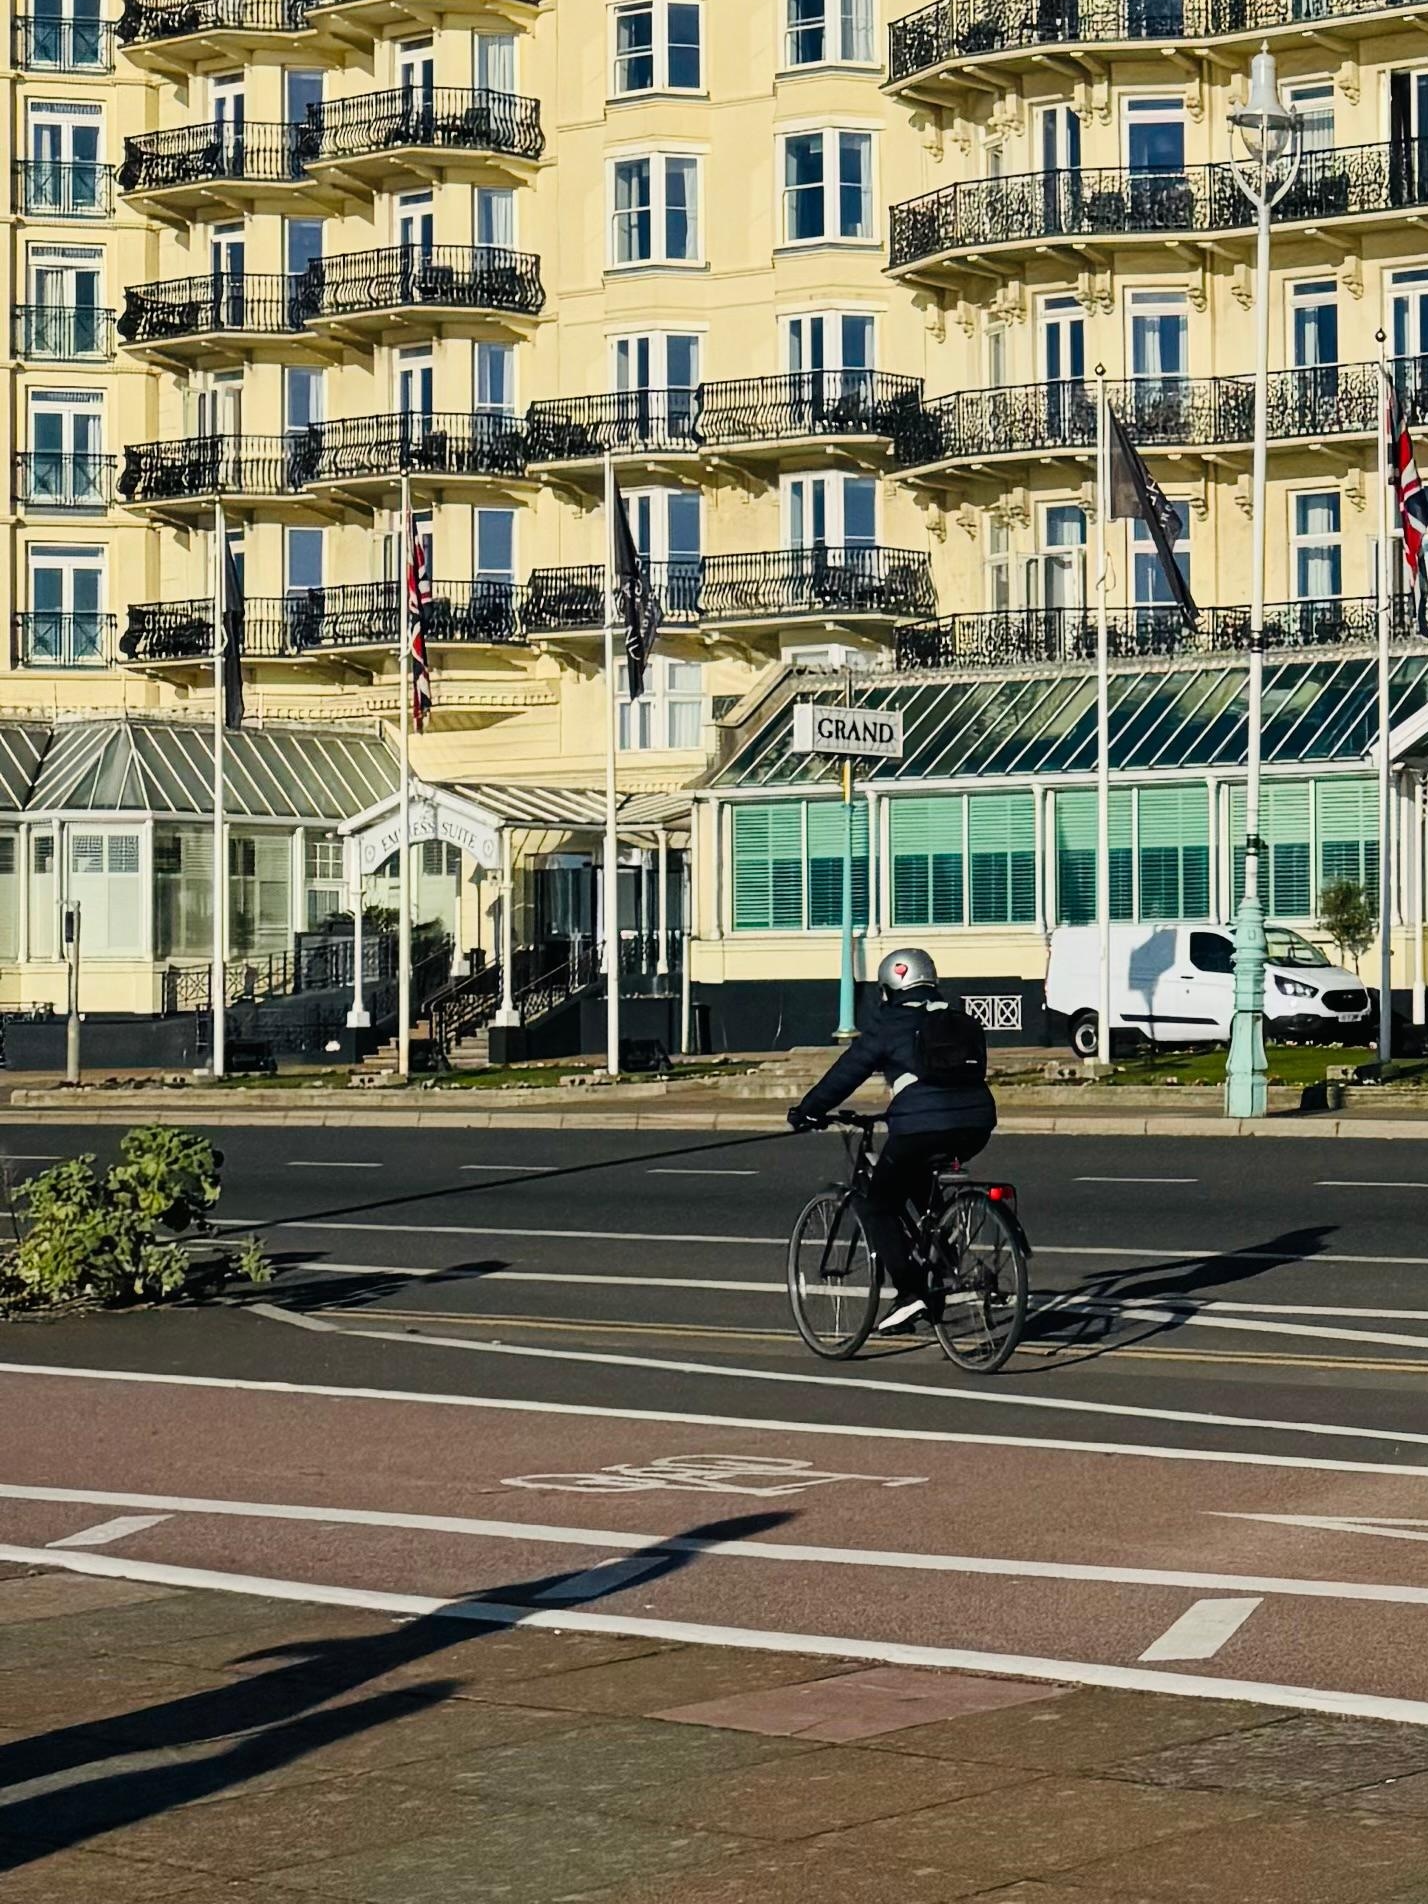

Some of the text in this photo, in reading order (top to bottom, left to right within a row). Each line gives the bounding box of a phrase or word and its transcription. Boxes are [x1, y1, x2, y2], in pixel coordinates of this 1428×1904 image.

[818, 718, 894, 743] GRAND
[382, 822, 477, 851] EMESS SUITE
